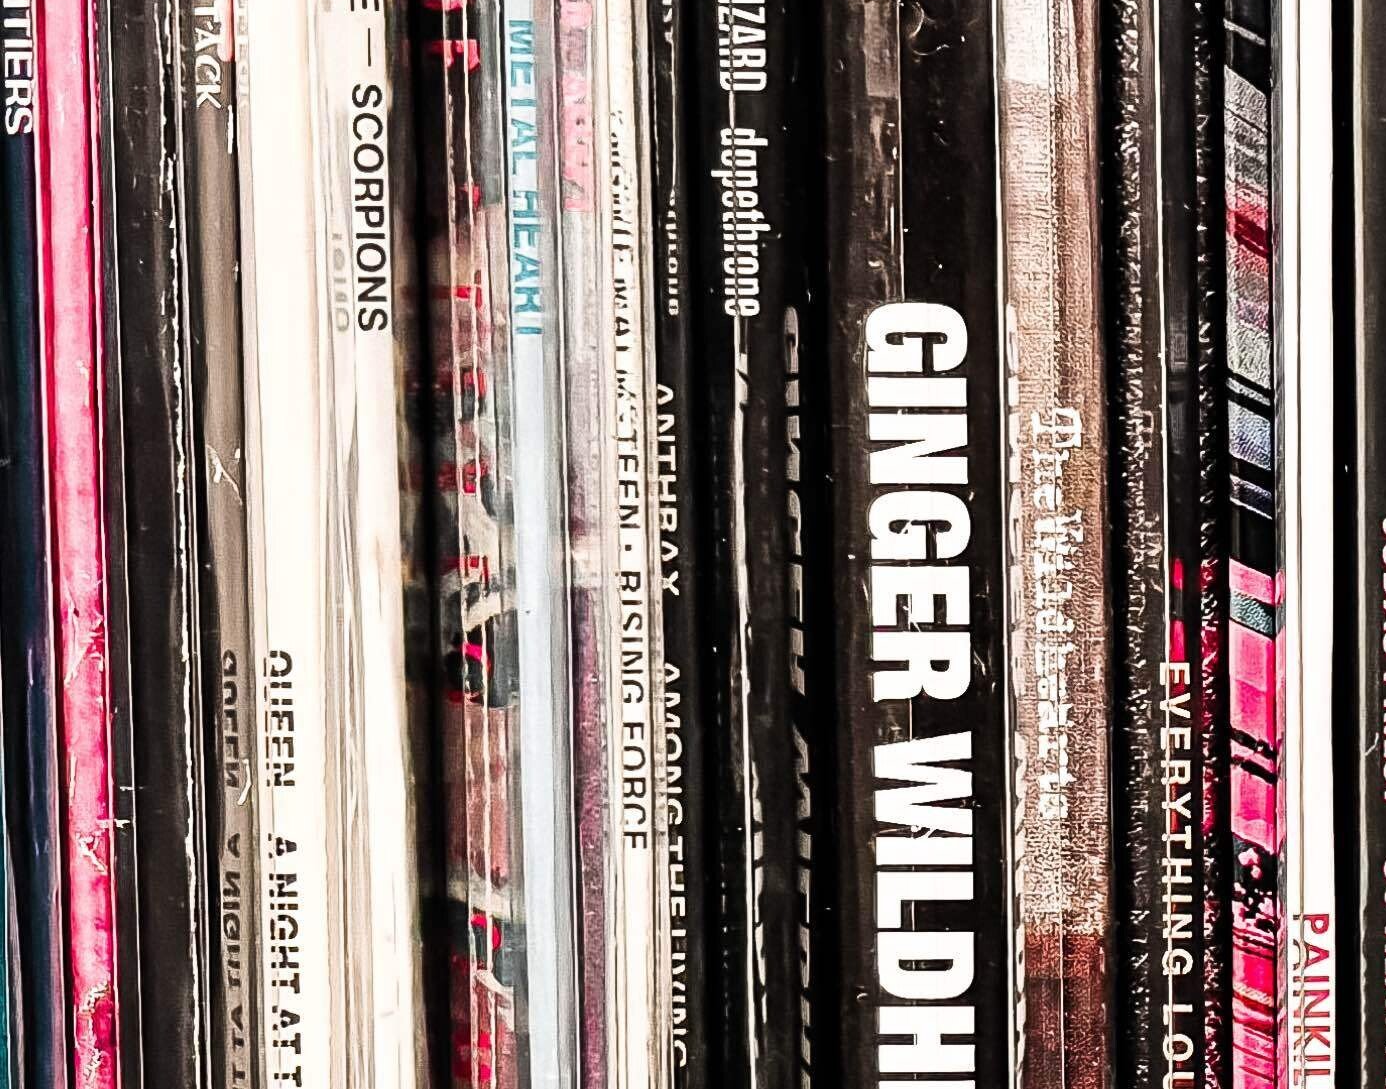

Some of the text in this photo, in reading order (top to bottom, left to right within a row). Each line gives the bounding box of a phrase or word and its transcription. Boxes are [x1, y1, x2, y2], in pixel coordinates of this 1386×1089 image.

[352, 84, 388, 332] SCORPIONS
[507, 19, 540, 176] METAL
[712, 127, 771, 316] dopethrone
[512, 189, 545, 336] HEART
[658, 384, 680, 596] ANTHRAX
[618, 570, 647, 850] RISING FORCE
[864, 304, 976, 1089] GINGER WILDH
[1160, 661, 1193, 976] EVERYTHING
[264, 650, 302, 1054] QUEEN A NIGHT AT
